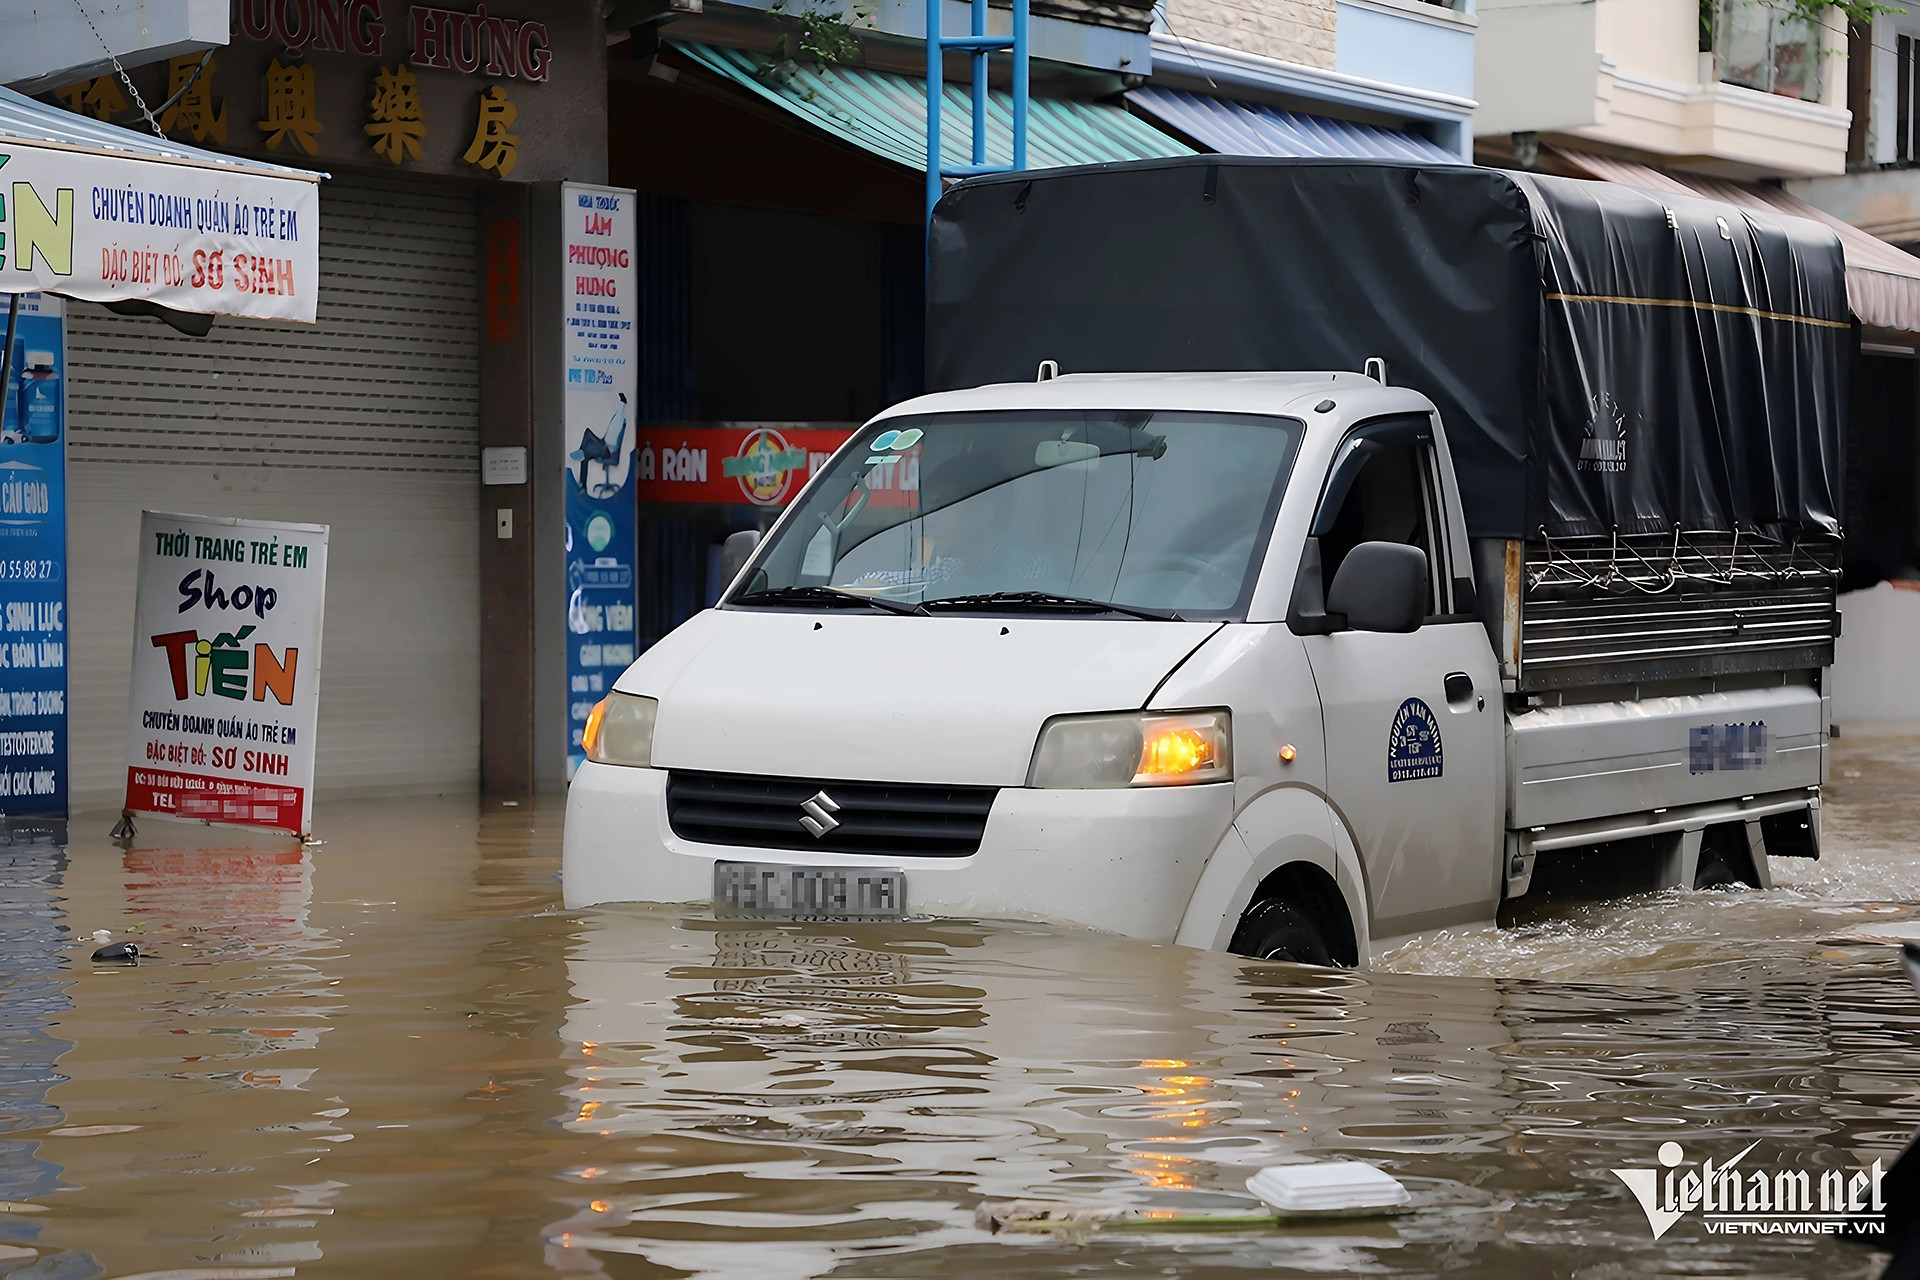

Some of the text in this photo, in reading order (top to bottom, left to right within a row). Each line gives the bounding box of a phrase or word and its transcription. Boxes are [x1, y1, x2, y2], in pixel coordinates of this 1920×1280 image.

[409, 3, 553, 83] HƯNG
[92, 183, 145, 225] CHUYÊN
[149, 193, 193, 230] DOANH
[233, 196, 250, 236] ÁO
[253, 197, 275, 240] TRẺ
[279, 209, 299, 242] EM
[101, 241, 128, 289] ĐẶC
[131, 244, 158, 291] BIỆT
[190, 249, 225, 291] SƠ
[233, 252, 296, 298] SINH
[662, 440, 708, 483] RÁN
[155, 528, 308, 569] THỜI TRANG TRẺ EM
[9, 560, 21, 580] 55
[23, 559, 37, 580] 88
[39, 559, 52, 580] 27
[178, 568, 278, 620] Shop
[6, 600, 35, 633] SINH
[142, 709, 180, 732] CHUYÊN
[182, 714, 215, 735] DOANH
[245, 719, 258, 741] ÁO
[261, 720, 278, 744] TRẺ
[281, 727, 297, 745] EM
[146, 739, 165, 765] ĐẶC
[168, 741, 189, 768] BIỆT
[211, 746, 238, 770] SƠ
[243, 750, 289, 777] SINH
[152, 792, 177, 809] TEL
